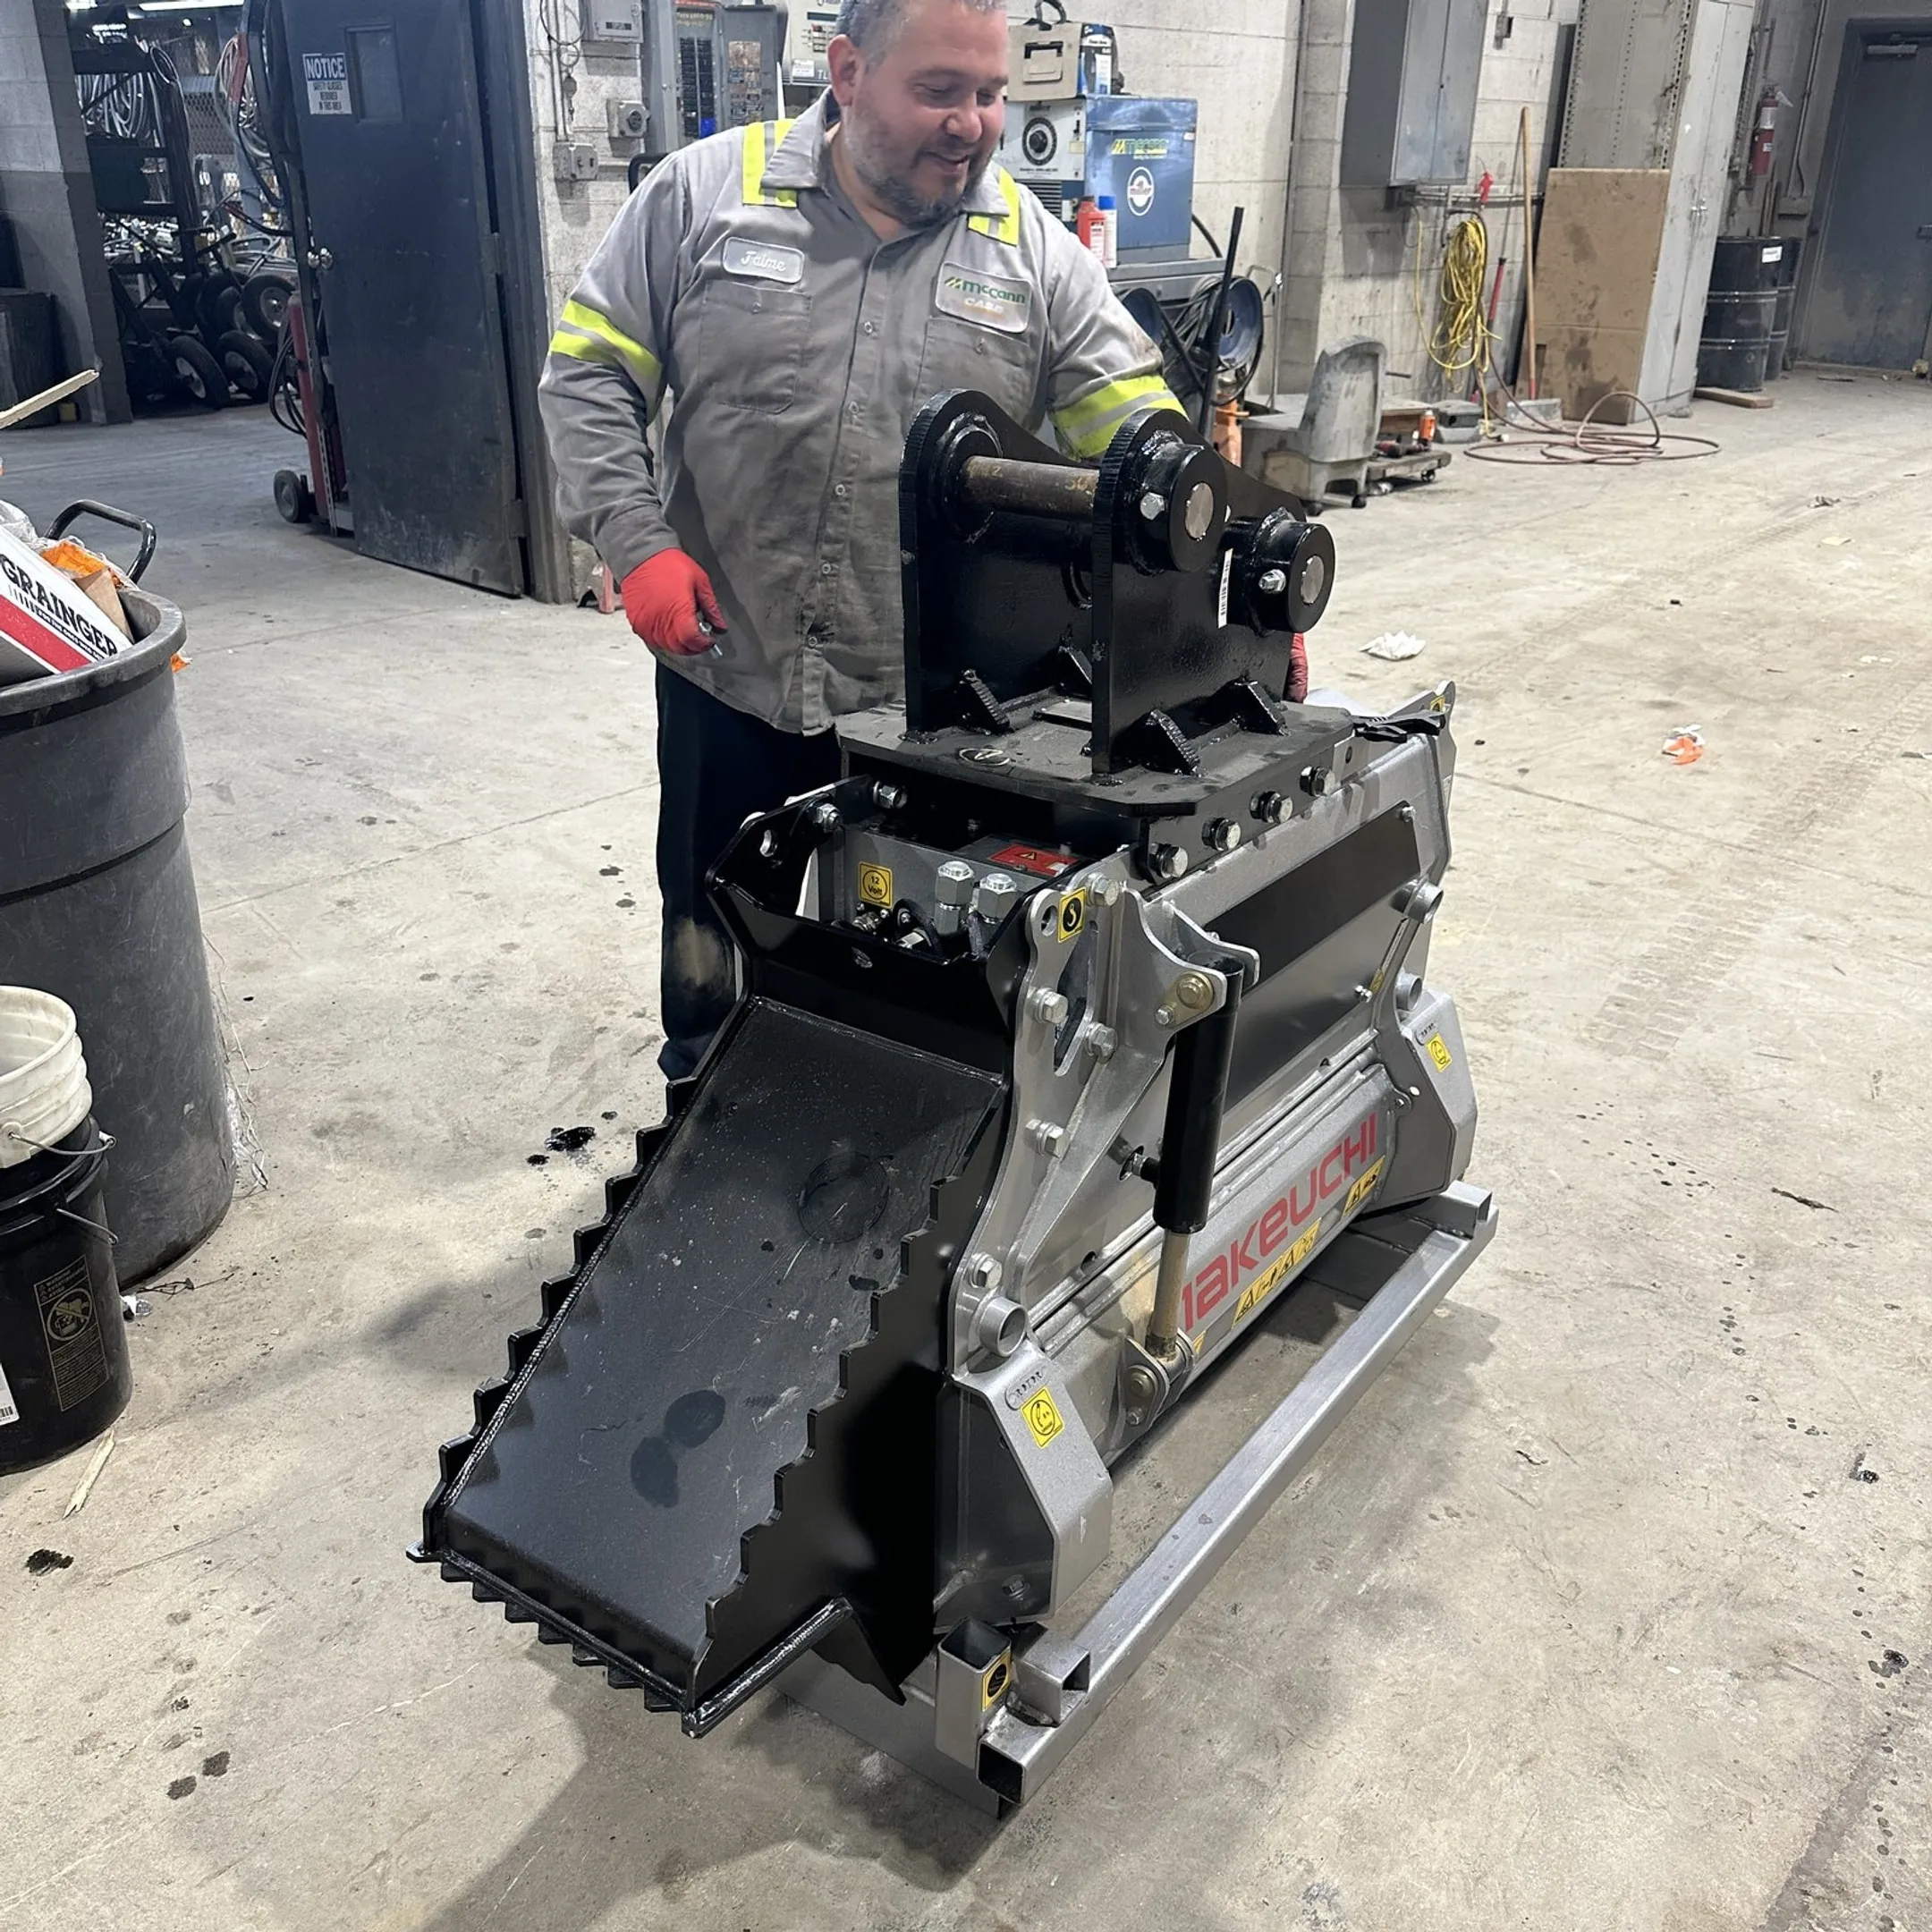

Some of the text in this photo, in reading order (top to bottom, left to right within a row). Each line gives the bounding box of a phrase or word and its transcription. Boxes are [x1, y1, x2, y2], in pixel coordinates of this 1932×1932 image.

[306, 57, 345, 79] NOTICE
[741, 250, 786, 272] Jaime
[1, 554, 117, 657] GRAINGER
[871, 876, 880, 885] 12
